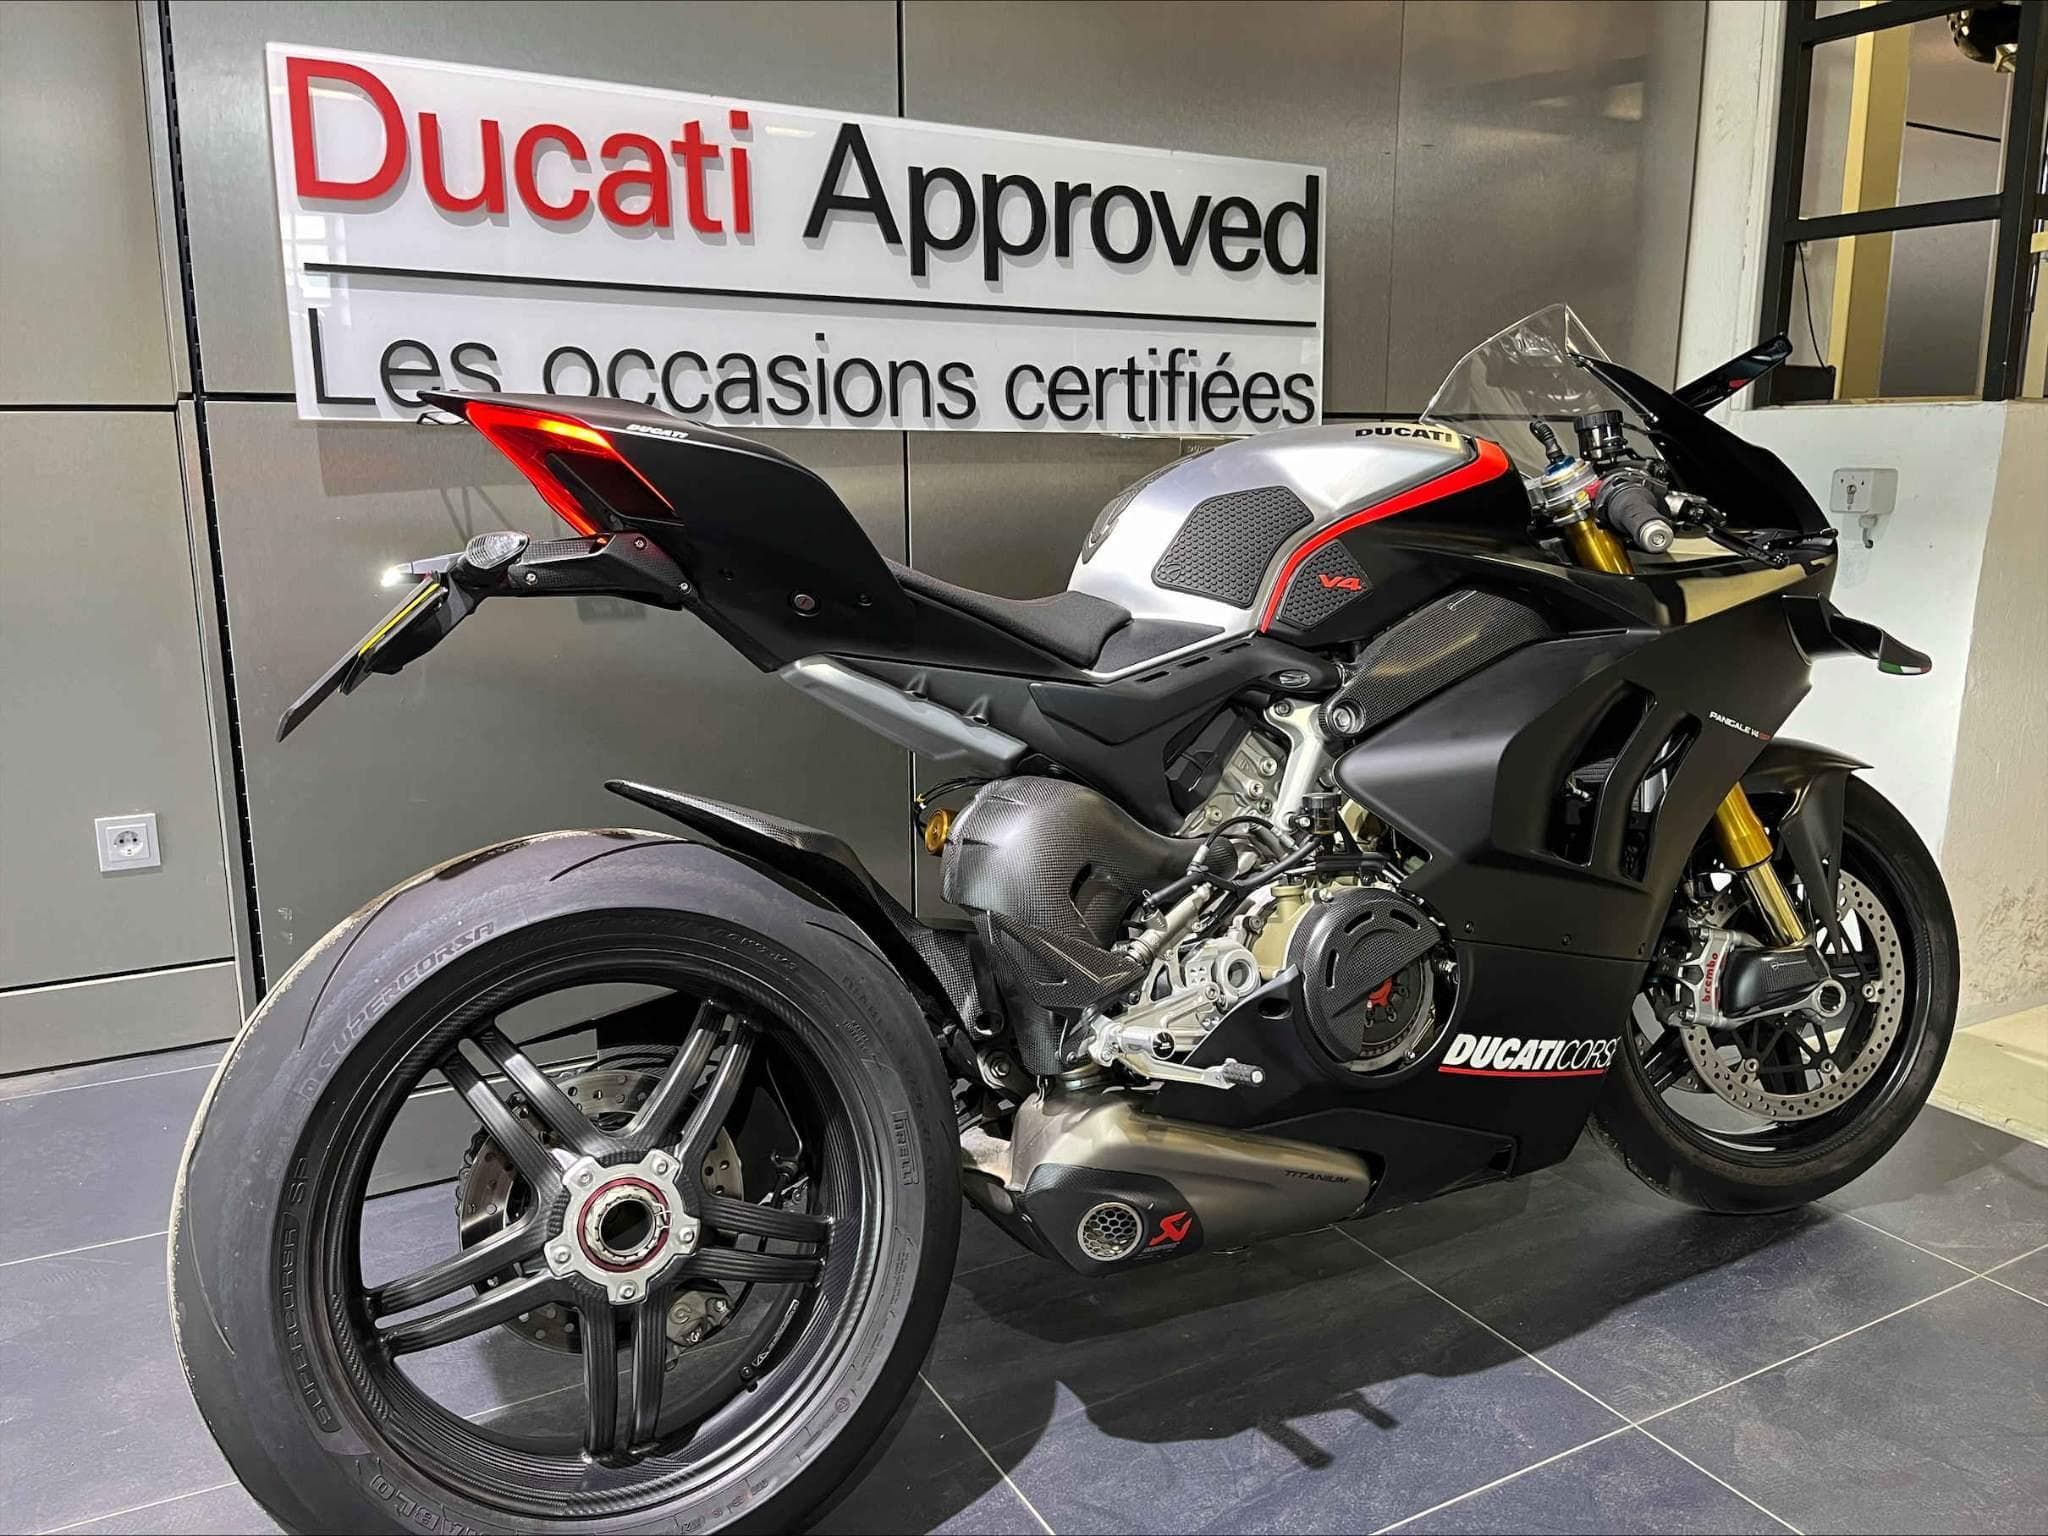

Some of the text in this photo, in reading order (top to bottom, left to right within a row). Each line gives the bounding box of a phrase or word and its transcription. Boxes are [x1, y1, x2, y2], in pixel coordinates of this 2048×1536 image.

[286, 57, 1320, 281] Ducati Approved
[308, 308, 1316, 424] Les occasions certifiées
[626, 424, 689, 439] DUCATI
[1355, 427, 1453, 443] DUCATI
[1318, 573, 1363, 592] V4
[318, 920, 495, 1068] SUPERCORSA
[1702, 952, 1719, 1003] brembo
[1285, 1169, 1350, 1184] TITANIUM
